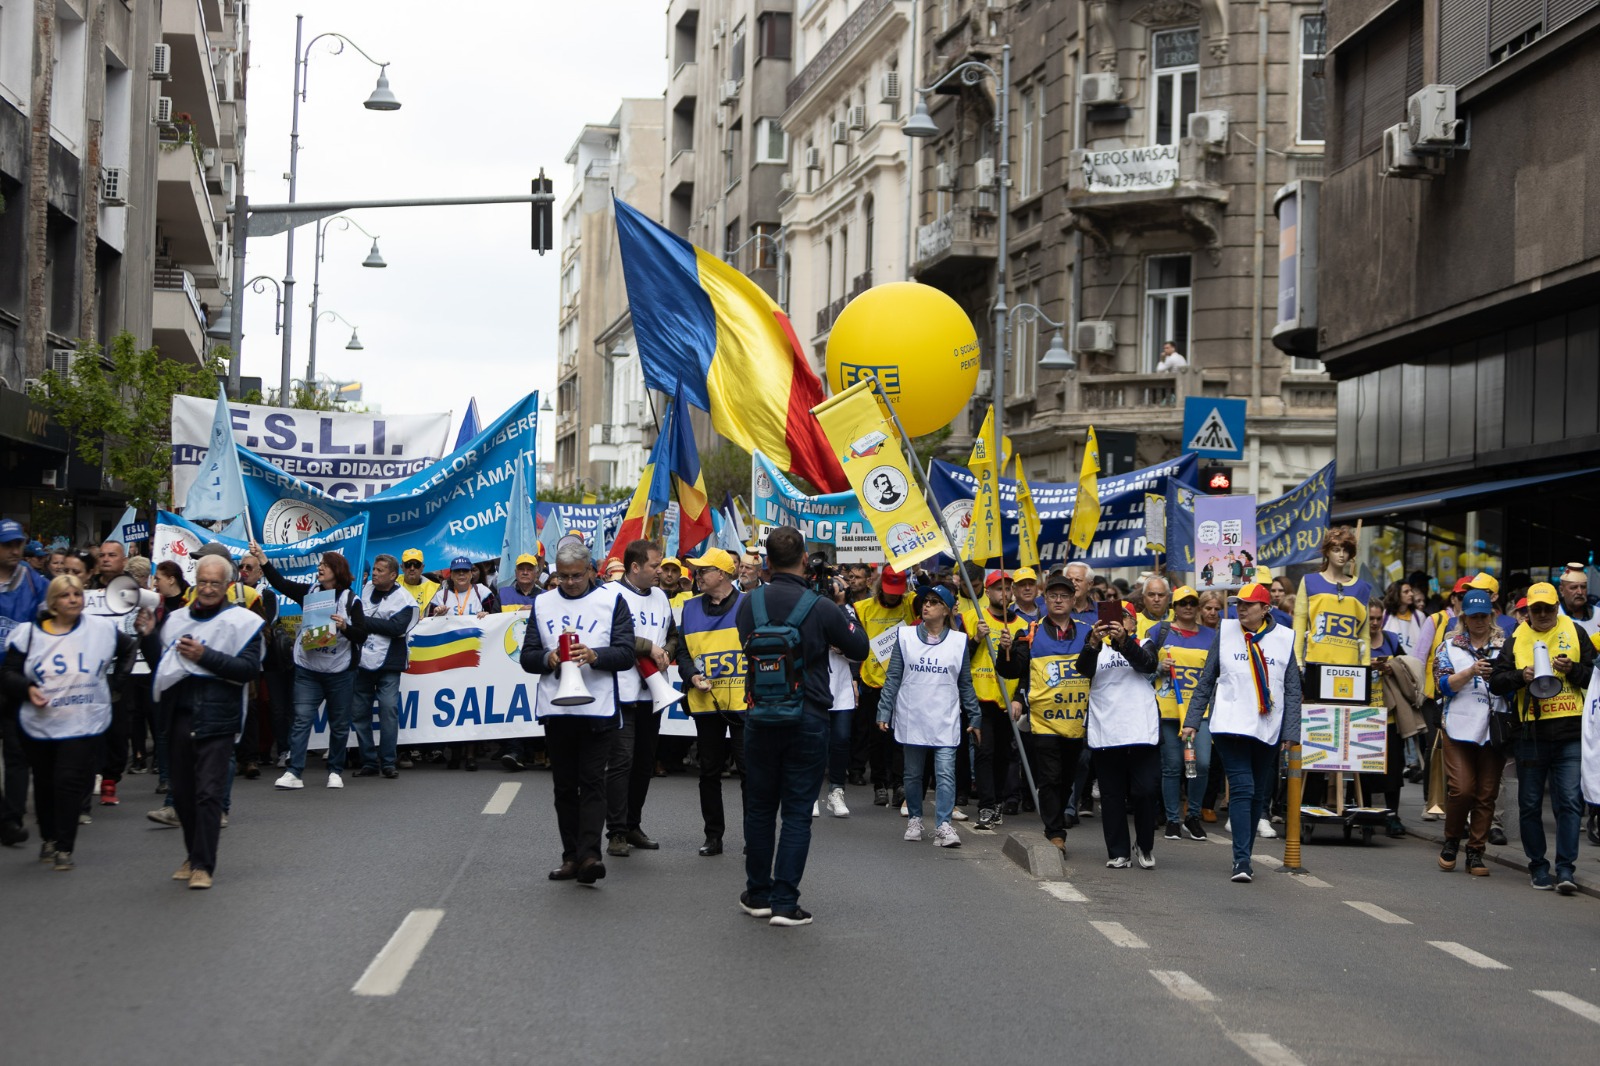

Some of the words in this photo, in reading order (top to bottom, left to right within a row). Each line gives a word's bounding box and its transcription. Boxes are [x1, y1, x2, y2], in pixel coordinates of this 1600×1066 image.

[1094, 151, 1128, 166] EROS
[1132, 146, 1177, 163] MASAJ
[842, 365, 900, 392] FSE
[483, 411, 537, 455] LIBERE
[1135, 466, 1179, 480] LIBERE
[387, 508, 420, 524] DIN
[766, 500, 864, 540] VRANCEA
[892, 531, 936, 558] Frăția
[546, 614, 598, 635] FSLI
[704, 652, 748, 677] FSE
[760, 662, 779, 671] LiveU
[909, 664, 948, 675] VRANCEA
[919, 657, 938, 666] SLI
[1326, 669, 1361, 677] EDUSAL
[432, 683, 539, 728] SALA
